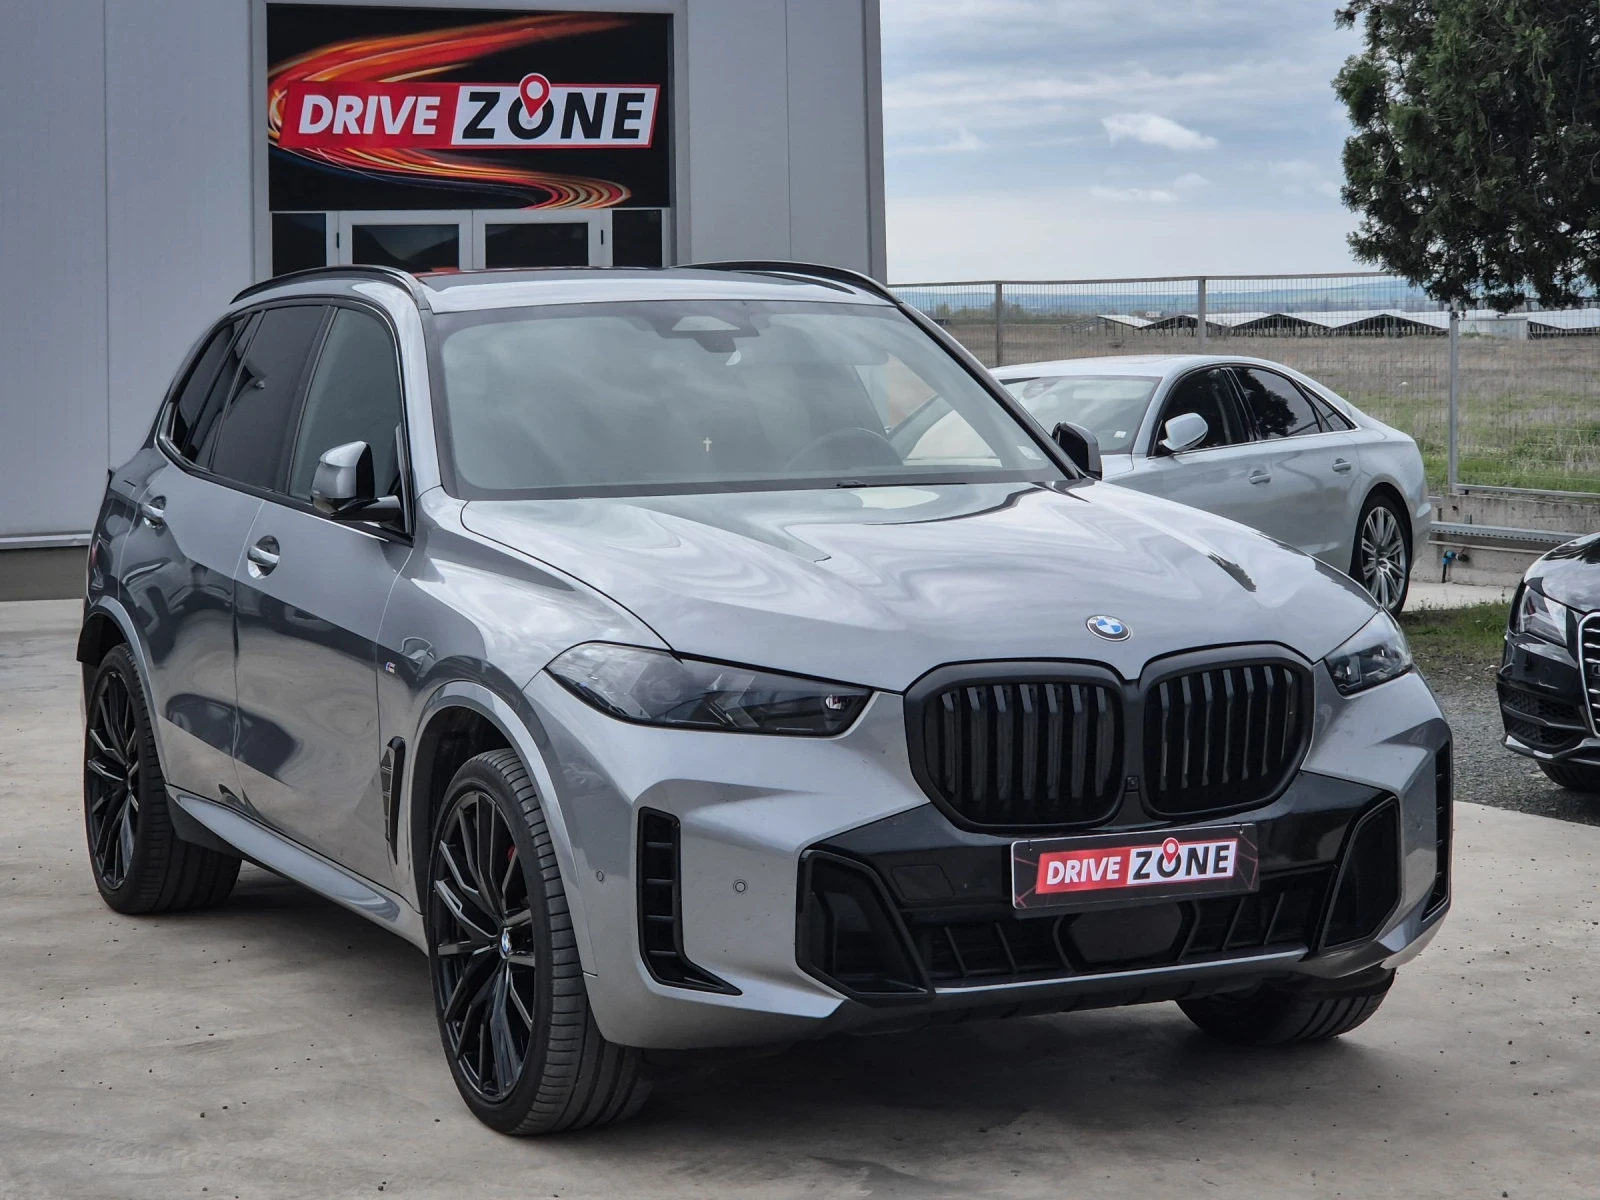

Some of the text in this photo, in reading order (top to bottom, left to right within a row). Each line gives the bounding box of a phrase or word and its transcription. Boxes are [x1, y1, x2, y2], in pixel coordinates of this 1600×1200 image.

[298, 90, 646, 140] DRIVE ZONE
[1046, 843, 1230, 885] DRIVE ZONE
